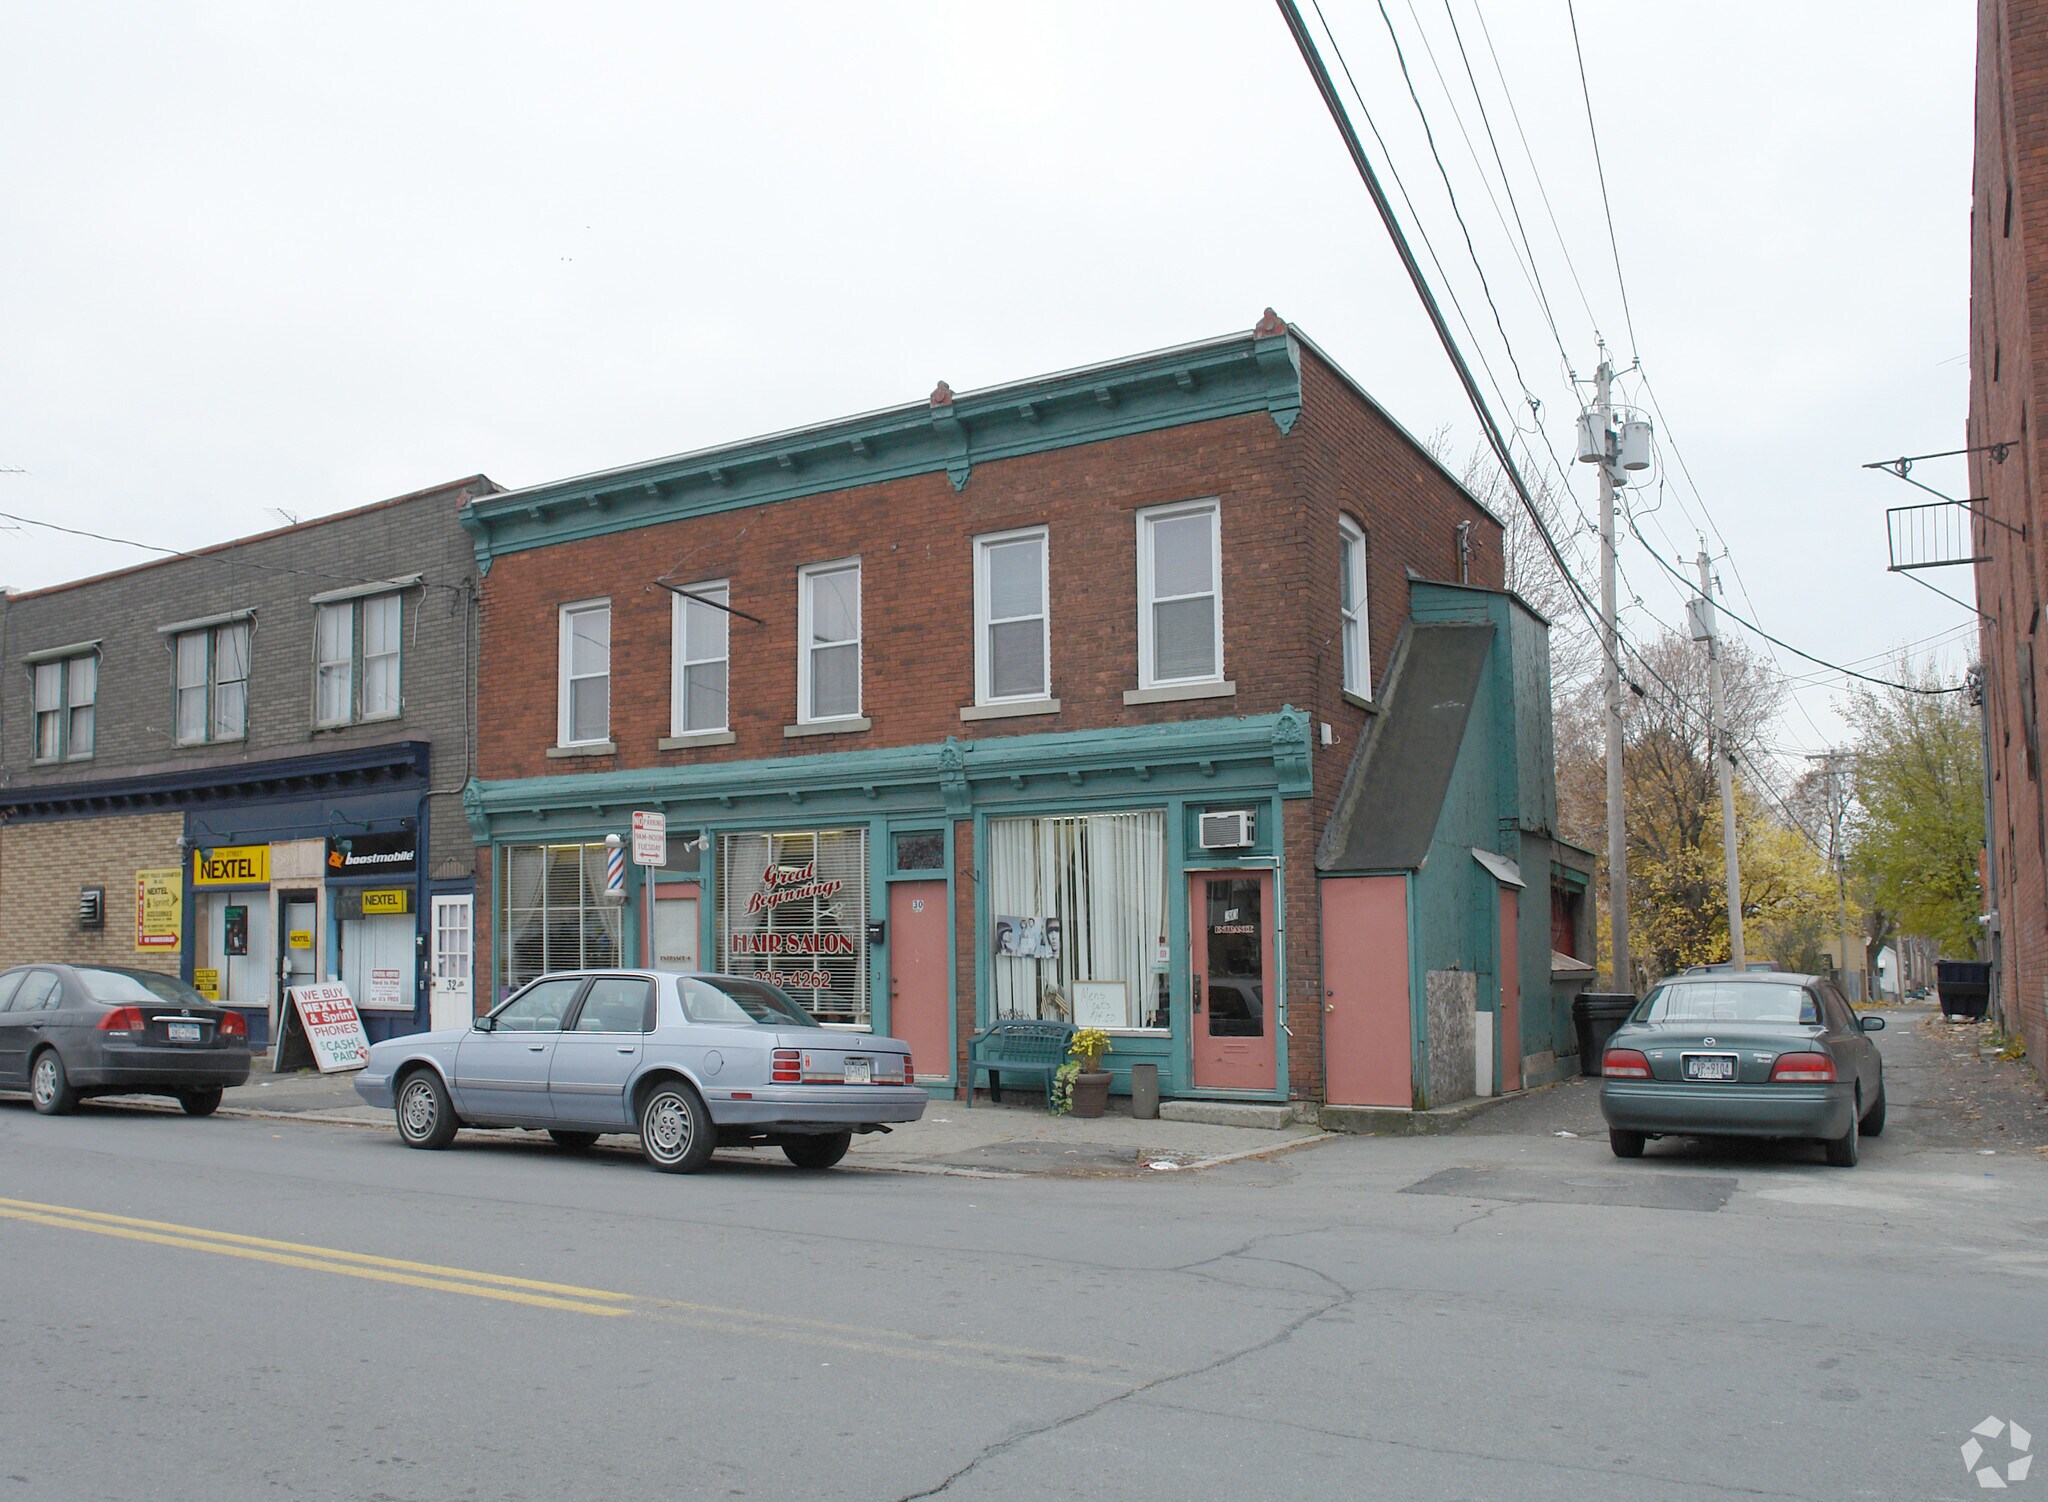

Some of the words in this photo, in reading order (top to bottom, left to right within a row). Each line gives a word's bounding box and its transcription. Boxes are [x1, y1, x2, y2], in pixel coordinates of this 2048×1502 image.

[634, 816, 643, 825] NO
[201, 859, 256, 879] NEXTEL
[762, 861, 815, 892] Great
[147, 887, 168, 895] NEXTEL
[365, 895, 398, 906] NEXTEL
[744, 880, 842, 917] Beginnings
[913, 900, 924, 909] 30
[732, 933, 783, 953] HAIR
[787, 933, 854, 954] SALON
[447, 979, 457, 991] 32
[754, 971, 832, 988] 235-4262
[301, 990, 319, 1000] WE
[322, 987, 343, 999] BUY
[303, 1000, 352, 1013] NEXTEL
[310, 1014, 319, 1023] &
[322, 1011, 354, 1024] Sprint
[314, 1023, 359, 1037] PHONES
[333, 1050, 357, 1062] PAID
